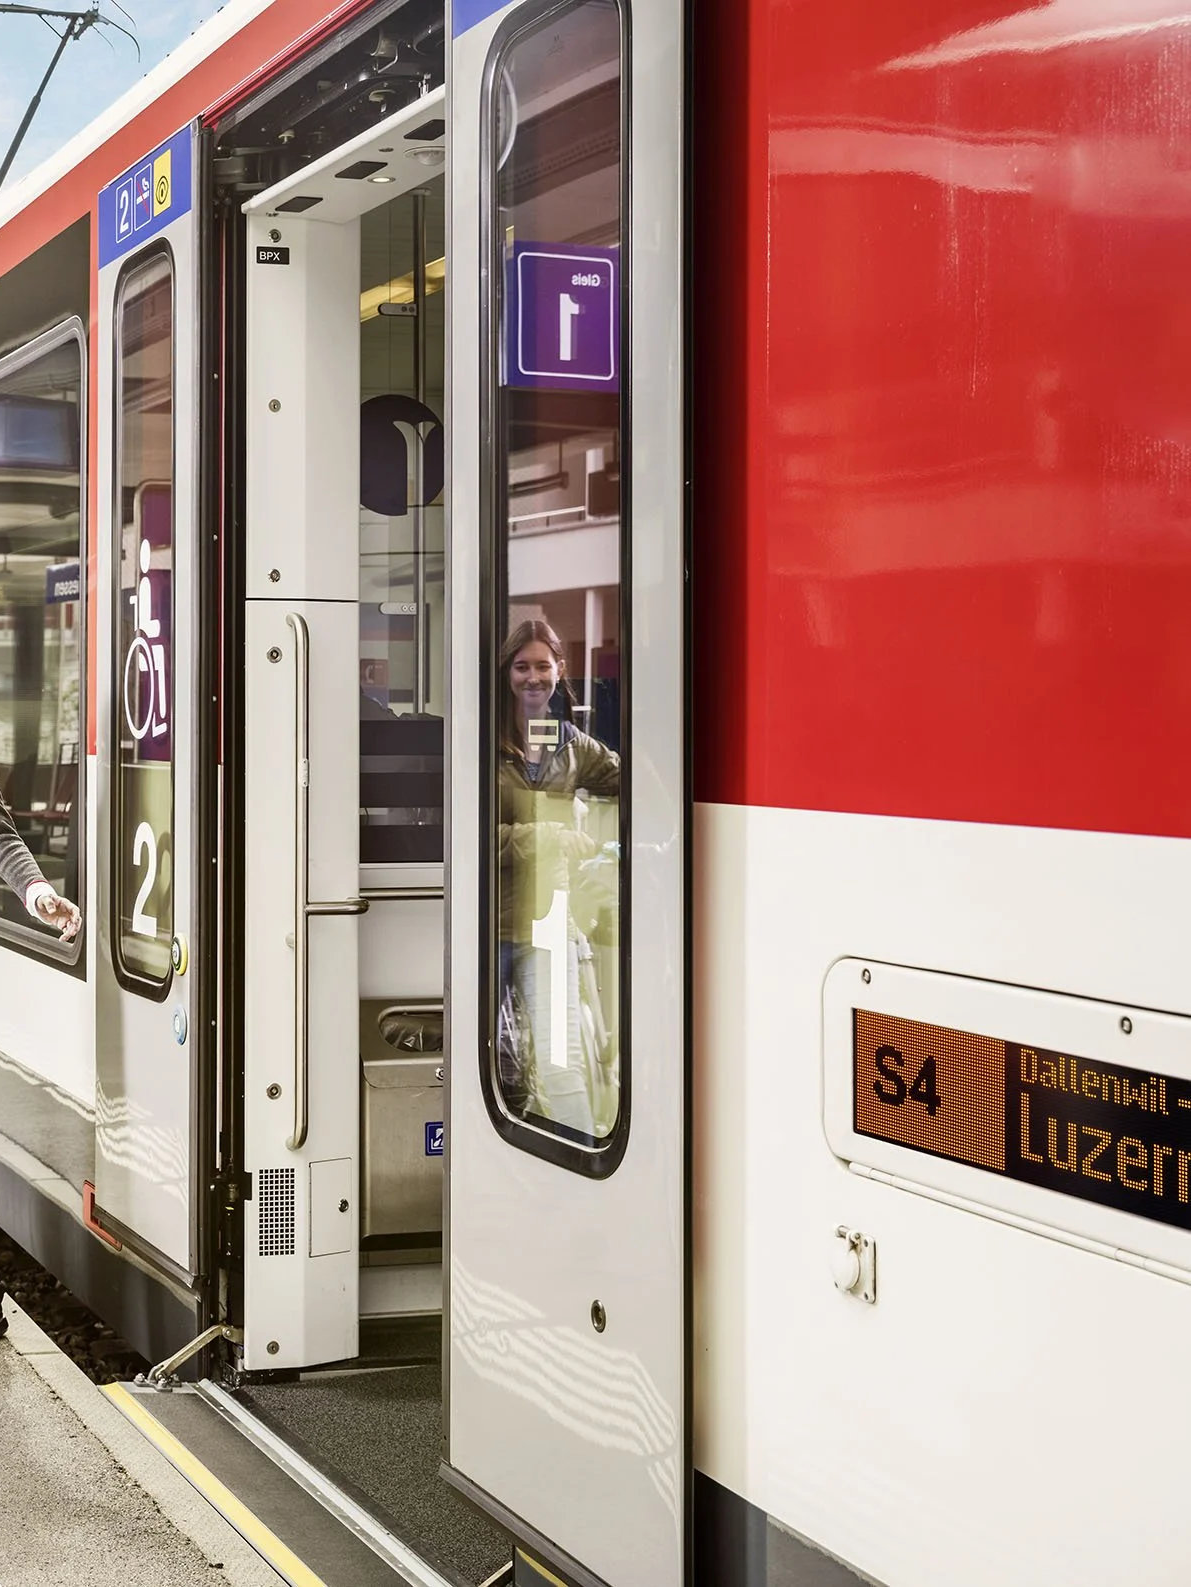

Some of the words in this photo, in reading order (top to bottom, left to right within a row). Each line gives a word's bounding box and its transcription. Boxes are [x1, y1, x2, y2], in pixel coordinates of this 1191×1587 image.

[120, 189, 129, 234] 2
[259, 251, 280, 261] BPX
[132, 821, 157, 938] 2
[532, 889, 568, 1069] 1
[873, 1045, 941, 1117] S4
[1020, 1048, 1169, 1116] Dallenwil
